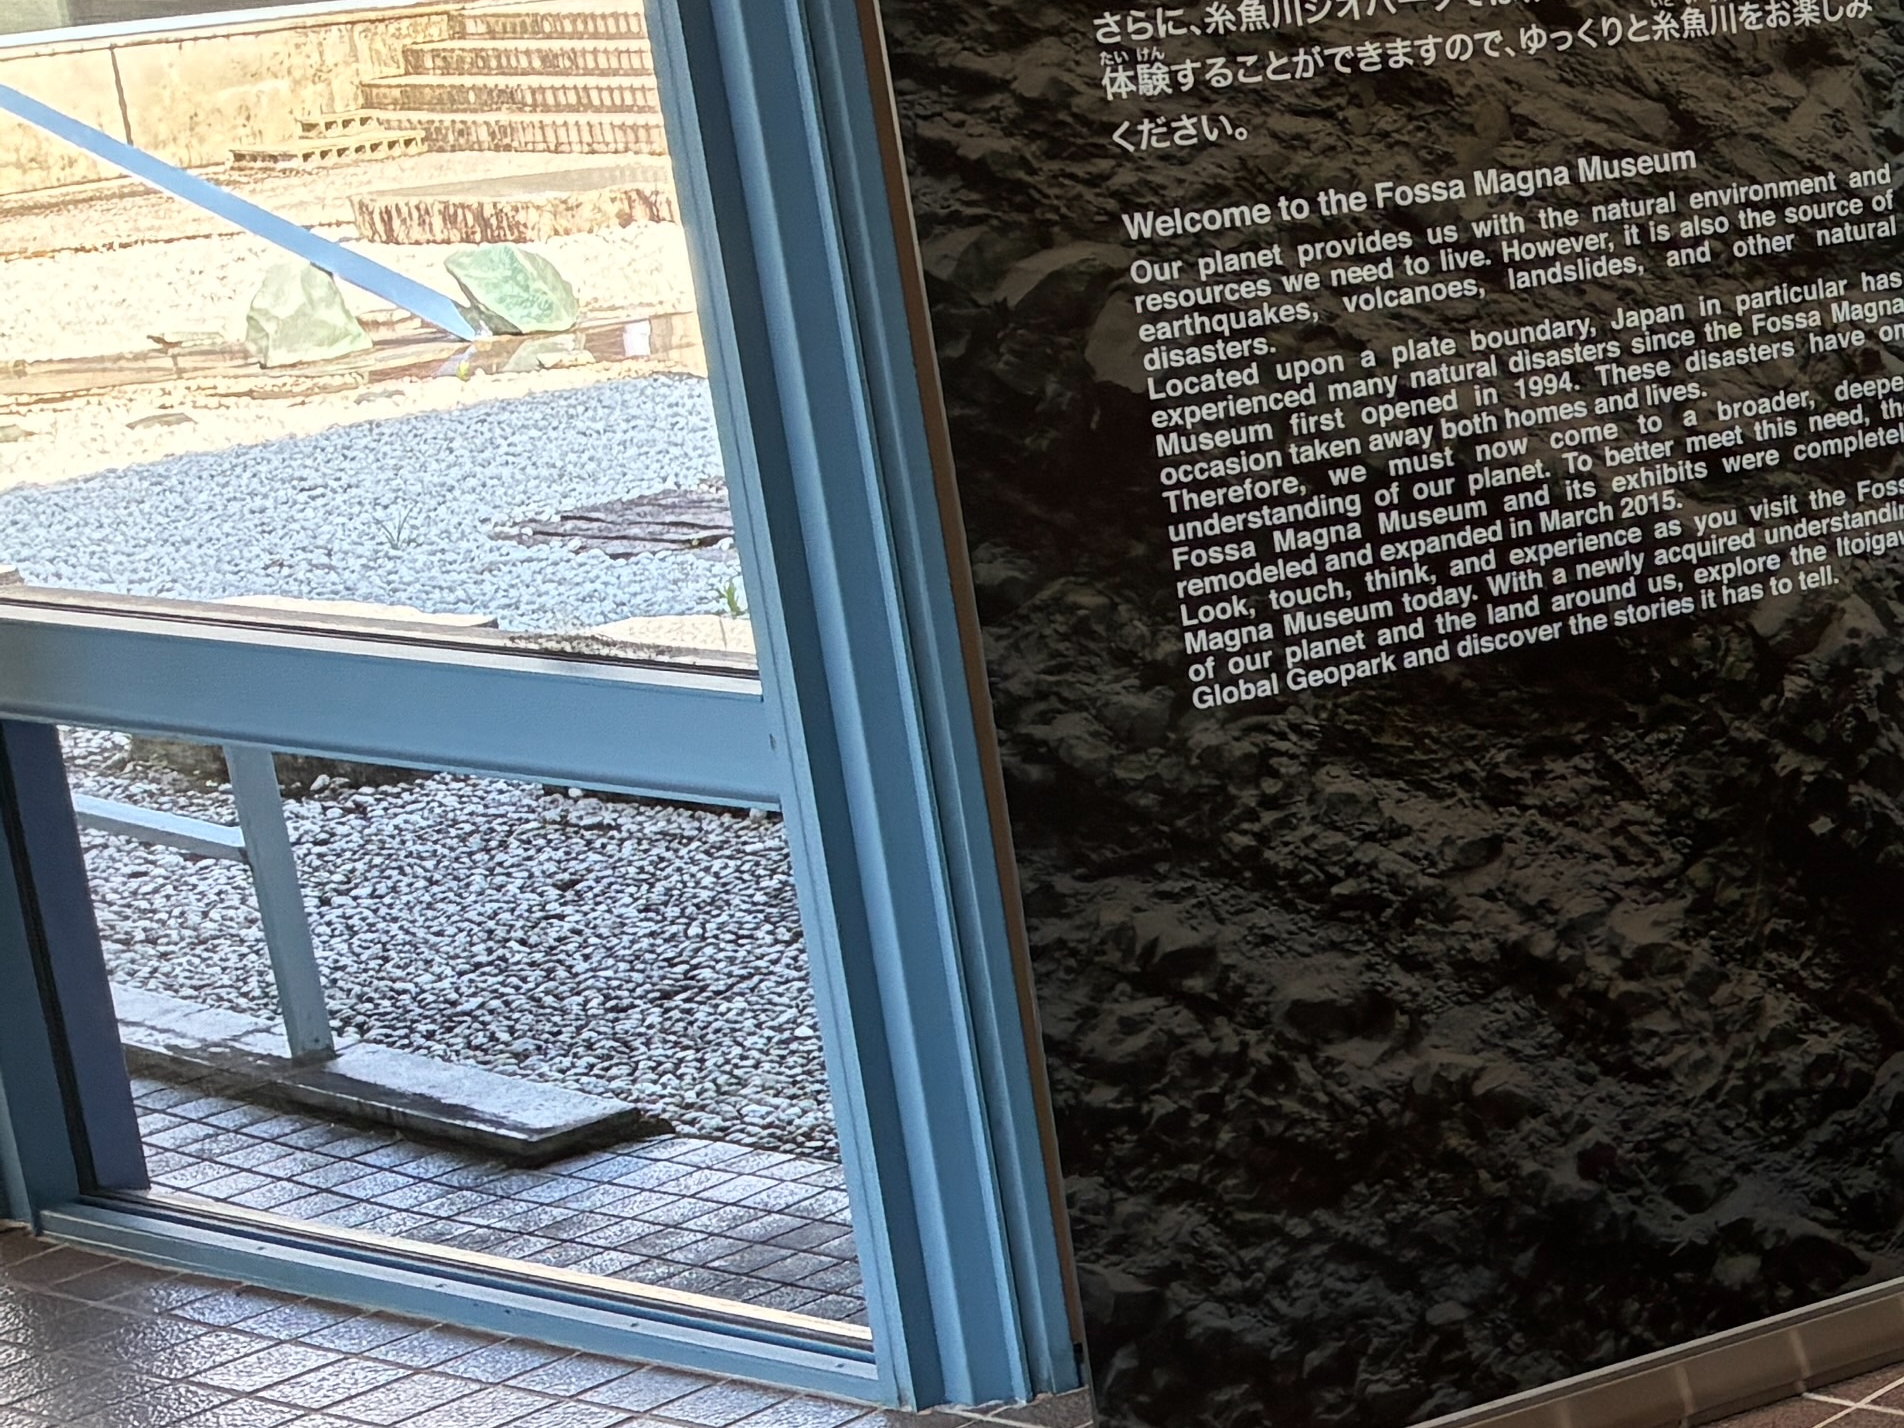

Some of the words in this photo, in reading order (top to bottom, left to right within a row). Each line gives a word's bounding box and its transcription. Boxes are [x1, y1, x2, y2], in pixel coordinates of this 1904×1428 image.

[1111, 113, 1248, 153] ください。
[1120, 202, 1271, 240] Welcome
[1276, 195, 1310, 221] to
[1316, 187, 1367, 216] the
[1373, 178, 1466, 209] Fossa
[1472, 165, 1570, 197] Magna
[1576, 148, 1697, 183] Museum
[1129, 258, 1183, 284] Our
[1196, 243, 1284, 282] planet
[1296, 228, 1413, 268] provides
[1425, 224, 1458, 245] us
[1470, 211, 1525, 238] with
[1536, 206, 1579, 230] the
[1590, 190, 1676, 223] natural
[1688, 170, 1837, 210] environment
[1847, 162, 1891, 189] and
[1137, 301, 1319, 342] earthquakes,
[1341, 277, 1486, 313] volcanoes,
[1506, 254, 1644, 290] landslides,
[1665, 239, 1711, 267] and
[1731, 232, 1795, 258] other
[1815, 214, 1897, 246] natural
[1146, 360, 1260, 400] Located
[1275, 353, 1345, 384] upon
[1359, 348, 1376, 368] a
[1390, 335, 1456, 369] plate
[1469, 316, 1597, 351] boundary,
[1609, 302, 1685, 331] Japan
[1697, 294, 1721, 317] in
[1734, 277, 1848, 317] particular
[1860, 270, 1903, 292] has
[1150, 381, 1317, 429] experienced
[1327, 373, 1398, 402] many
[1409, 353, 1498, 389] natural
[1507, 339, 1621, 373] disasters
[1630, 328, 1695, 354] since
[1702, 319, 1743, 342] the
[1750, 309, 1822, 336] Fossa
[1155, 422, 1274, 458] Museum
[1288, 407, 1346, 436] first
[1360, 387, 1459, 427] opened
[1472, 383, 1498, 407] in
[1513, 370, 1580, 400] 1994.
[1593, 359, 1671, 386] These
[1684, 339, 1795, 373] disasters
[1808, 329, 1866, 354] have
[1159, 449, 1283, 485] occasion
[1287, 436, 1361, 464] taken
[1367, 424, 1433, 452] away
[1439, 410, 1498, 440] both
[1503, 399, 1588, 430] homes
[1593, 386, 1639, 415] and
[1644, 381, 1708, 406] lives.
[1161, 475, 1306, 513] Therefore,
[1327, 464, 1367, 486] we
[1387, 445, 1455, 476] must
[1474, 436, 1528, 462] now
[1549, 421, 1618, 449] come
[1635, 413, 1663, 434] to
[1681, 408, 1698, 427] a
[1716, 389, 1815, 421] broader,
[1167, 492, 1362, 542] understanding
[1373, 480, 1400, 507] of
[1411, 476, 1455, 500] our
[1467, 457, 1551, 496] planet.
[1560, 450, 1593, 474] To
[1603, 438, 1674, 467] better
[1684, 423, 1744, 453] meet
[1752, 416, 1797, 441] this
[1808, 402, 1870, 433] need,
[1171, 539, 1257, 571] Fossa
[1272, 521, 1362, 553] Magna
[1377, 499, 1487, 535] Museum
[1502, 482, 1550, 512] and
[1564, 478, 1597, 501] its
[1610, 459, 1708, 493] exhibits
[1720, 448, 1780, 473] were
[1176, 551, 1318, 599] remodeled
[1324, 542, 1373, 572] and
[1379, 518, 1503, 562] expanded
[1508, 516, 1533, 538] in
[1538, 500, 1614, 533] March
[1619, 488, 1683, 519] 2015.
[1179, 593, 1256, 627] Look,
[1267, 576, 1352, 610] touch,
[1363, 561, 1437, 593] think,
[1449, 547, 1496, 577] and
[1508, 526, 1642, 566] experience
[1653, 518, 1682, 539] as
[1692, 508, 1737, 537] you
[1748, 493, 1799, 521] visit
[1807, 487, 1846, 510] the
[1183, 621, 1274, 655] Magna
[1282, 599, 1393, 636] Museum
[1400, 584, 1478, 613] today.
[1485, 567, 1543, 597] With
[1551, 566, 1567, 585] a
[1574, 549, 1645, 581] newly
[1653, 526, 1756, 566] acquired
[1191, 671, 1279, 709] Global
[1285, 650, 1397, 691] Geopark
[1402, 638, 1450, 669] and
[1456, 620, 1562, 658] discover
[1567, 612, 1608, 635] the
[1612, 595, 1695, 627] stories
[1699, 588, 1717, 609] it
[1720, 582, 1764, 605] has
[1768, 575, 1793, 596] to
[1797, 563, 1839, 591] tell.
